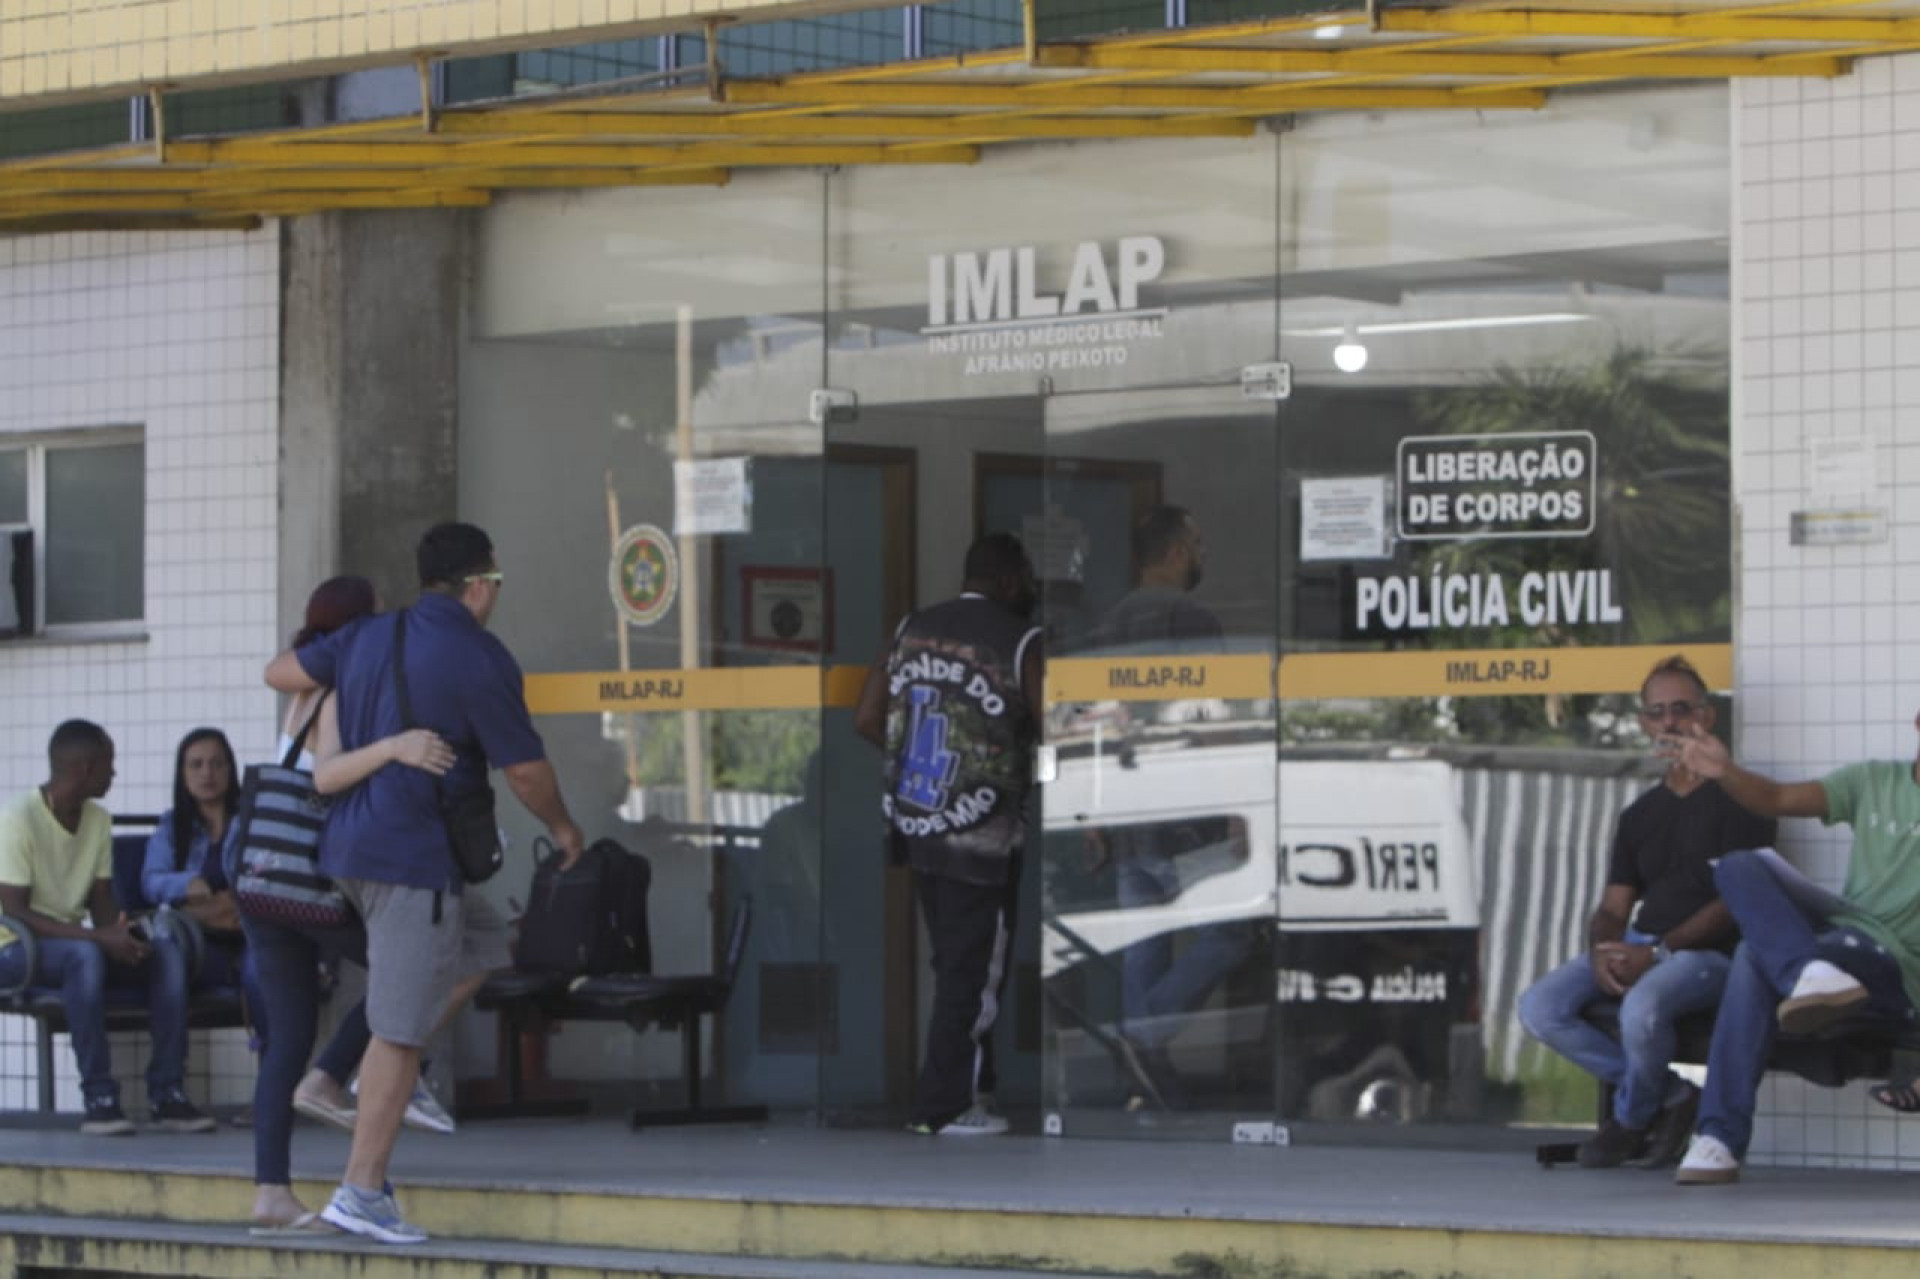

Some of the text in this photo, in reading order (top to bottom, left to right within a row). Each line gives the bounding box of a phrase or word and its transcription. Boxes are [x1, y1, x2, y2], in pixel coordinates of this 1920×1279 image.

[928, 236, 1165, 325] IMLAP
[929, 330, 1025, 354] INSTITUTO
[1102, 319, 1164, 340] LEGAL
[1050, 347, 1128, 370] PEIXOTO
[1408, 443, 1585, 486] LIBERAÇÃO
[1408, 494, 1450, 524] DE
[1455, 490, 1583, 522] CORPOS
[1356, 562, 1622, 630] POLÍCIA CIVIL
[1108, 665, 1206, 689] IMLAP-RJ
[1445, 657, 1550, 682] IMLAP-RJ
[599, 678, 685, 700] IMLAP-RJ
